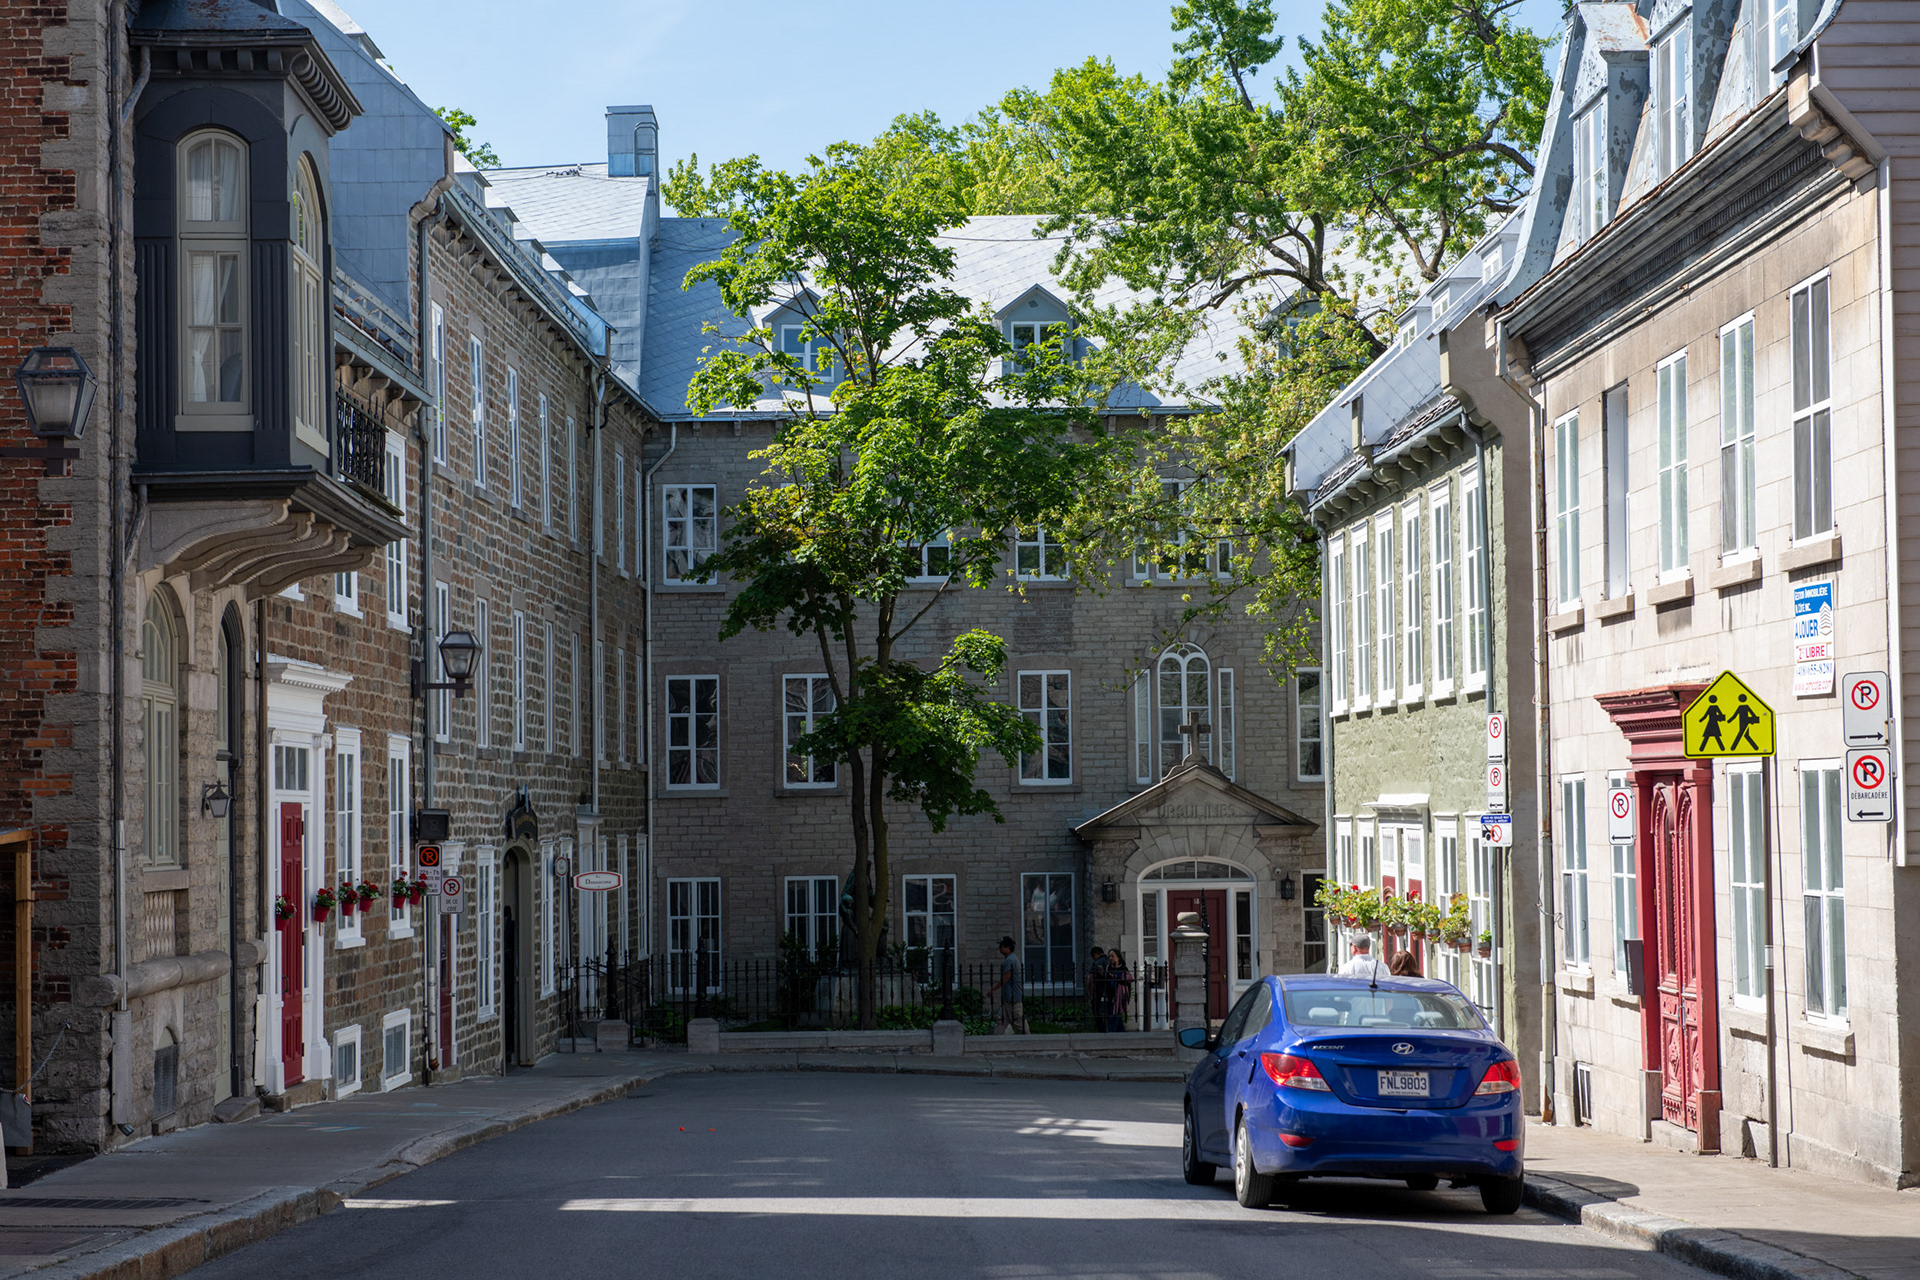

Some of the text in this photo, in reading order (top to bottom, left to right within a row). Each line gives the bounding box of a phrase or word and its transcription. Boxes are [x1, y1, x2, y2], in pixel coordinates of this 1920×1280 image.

[1799, 619, 1818, 638] LOUER
[1805, 645, 1825, 658] LIBRE
[1851, 790, 1888, 799] DÉBARCADÈRE
[1158, 804, 1236, 818] URSULINES
[1380, 1077, 1427, 1090] FNL9803
